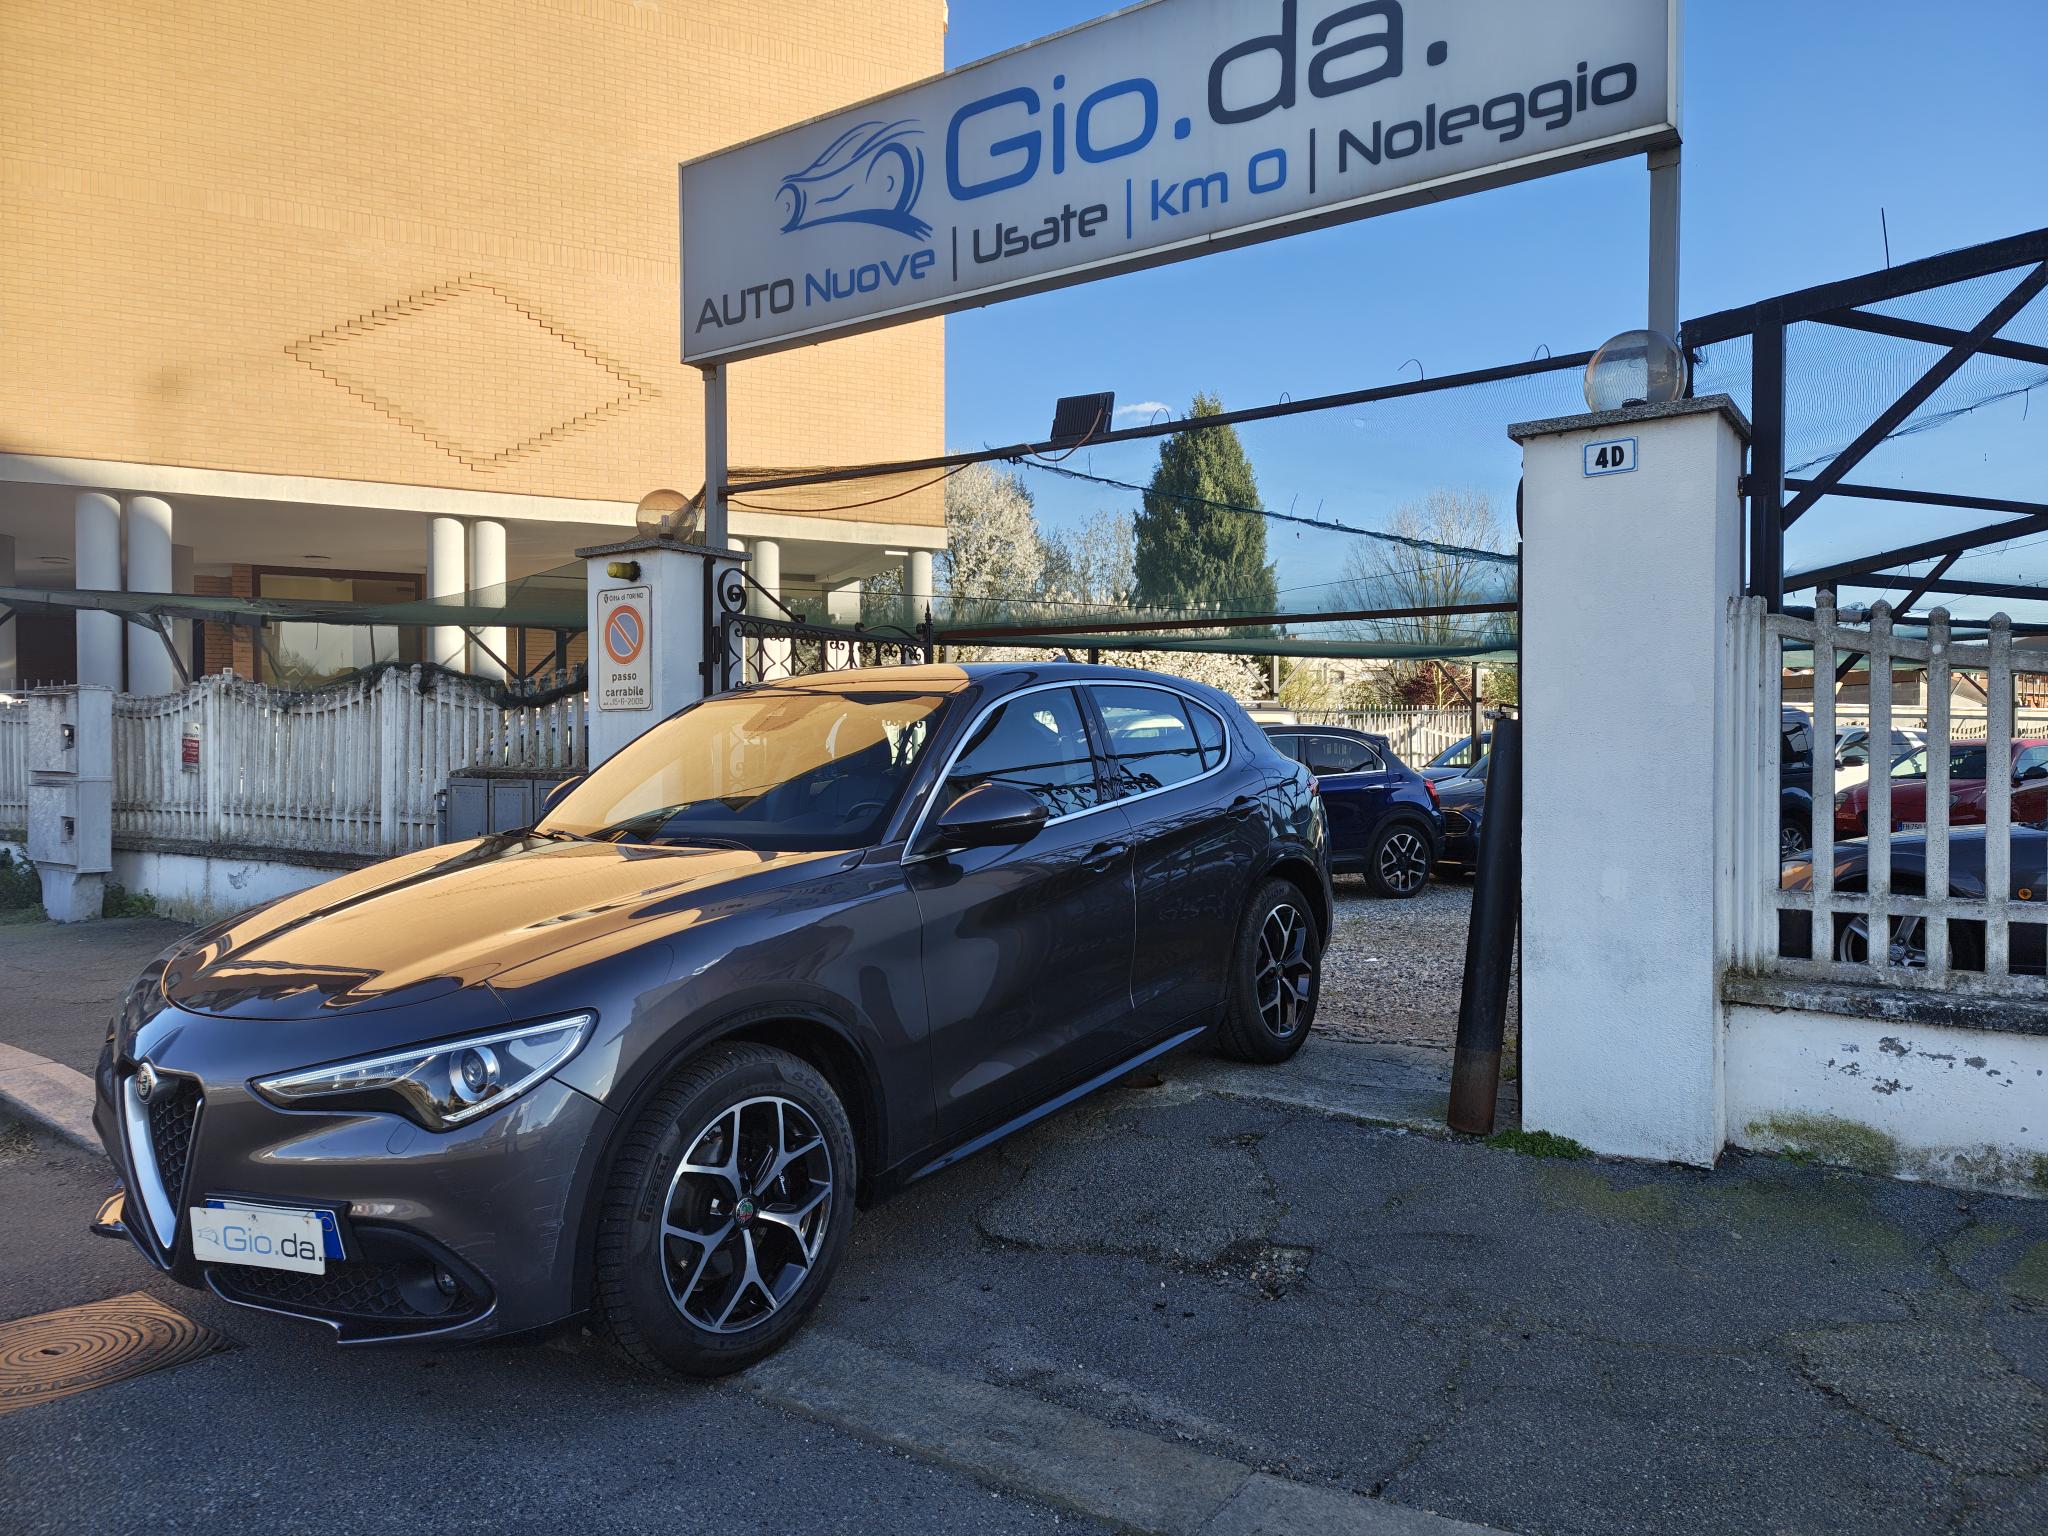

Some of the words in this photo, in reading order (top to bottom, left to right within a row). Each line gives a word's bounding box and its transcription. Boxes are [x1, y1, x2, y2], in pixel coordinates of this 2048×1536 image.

[695, 277, 794, 334] AUTO
[805, 248, 935, 306] Nuove
[972, 203, 1108, 264] Usate
[1151, 171, 1229, 220] km
[1339, 61, 1638, 174] Noleggio
[1595, 445, 1625, 469] 4D
[611, 672, 637, 683] passo
[605, 686, 644, 697] carrabile
